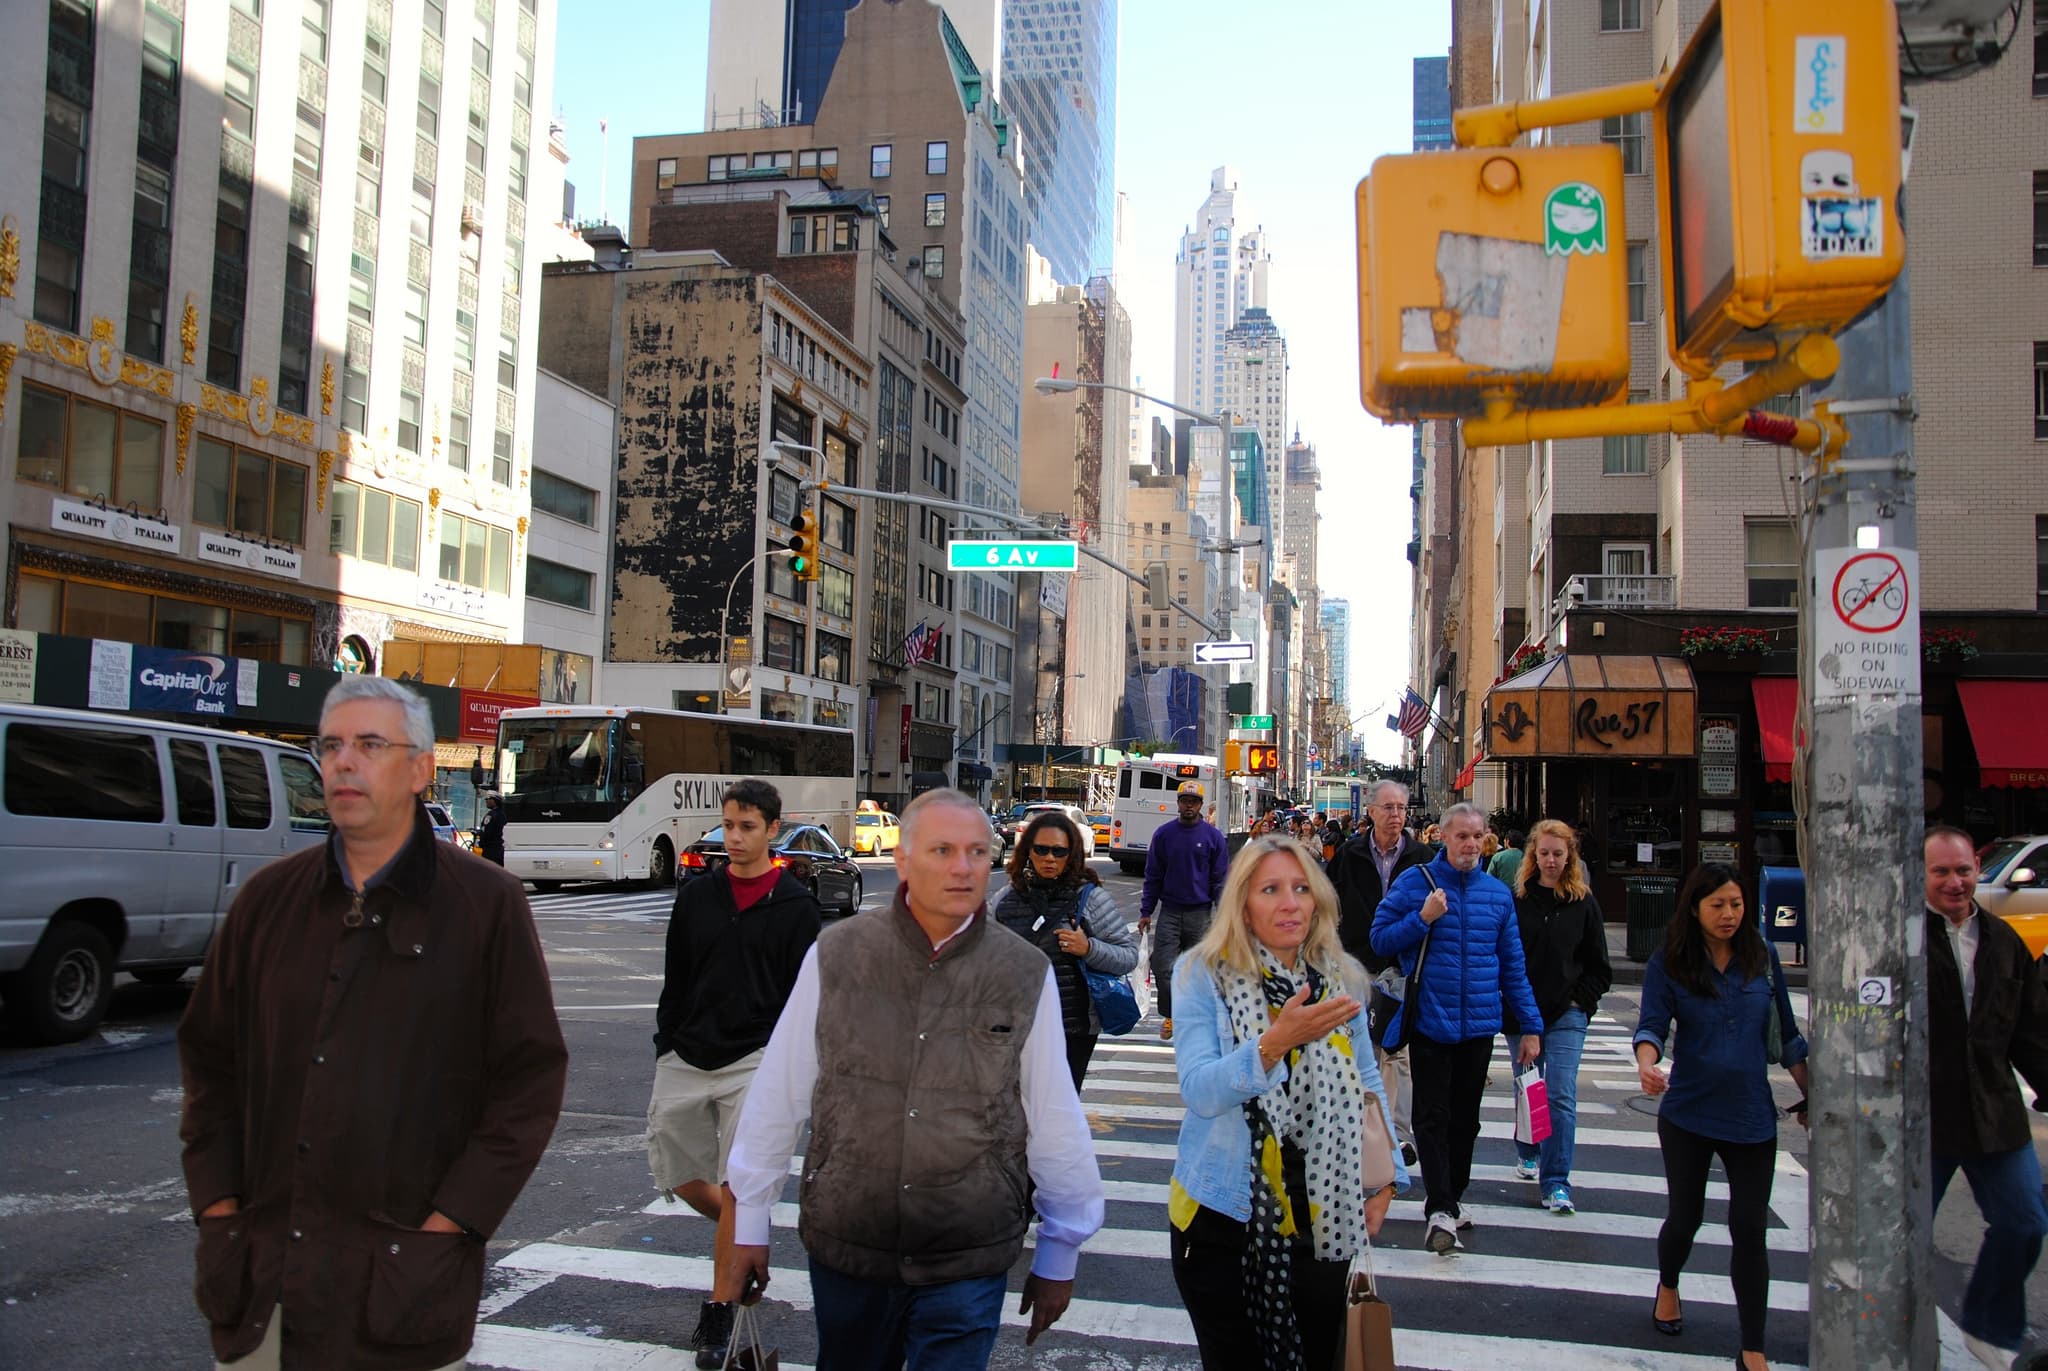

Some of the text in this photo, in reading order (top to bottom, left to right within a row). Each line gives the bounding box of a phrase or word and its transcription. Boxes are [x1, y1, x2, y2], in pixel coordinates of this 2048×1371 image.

[61, 511, 174, 543] QUALITY ITALIAN
[206, 543, 296, 569] QUALITY ITALIAN
[986, 547, 1039, 565] 6 Av
[1834, 641, 1908, 656] NO RIDING
[1861, 659, 1885, 672] ON
[1834, 676, 1906, 690] SIDEWALK
[195, 699, 226, 713] Bank
[470, 703, 502, 714] QUALITY
[1250, 717, 1257, 728] 6
[1577, 698, 1661, 748] Rue 57
[1266, 750, 1277, 768] 15
[2009, 773, 2048, 782] BREA
[673, 779, 733, 810] SKYLIN
